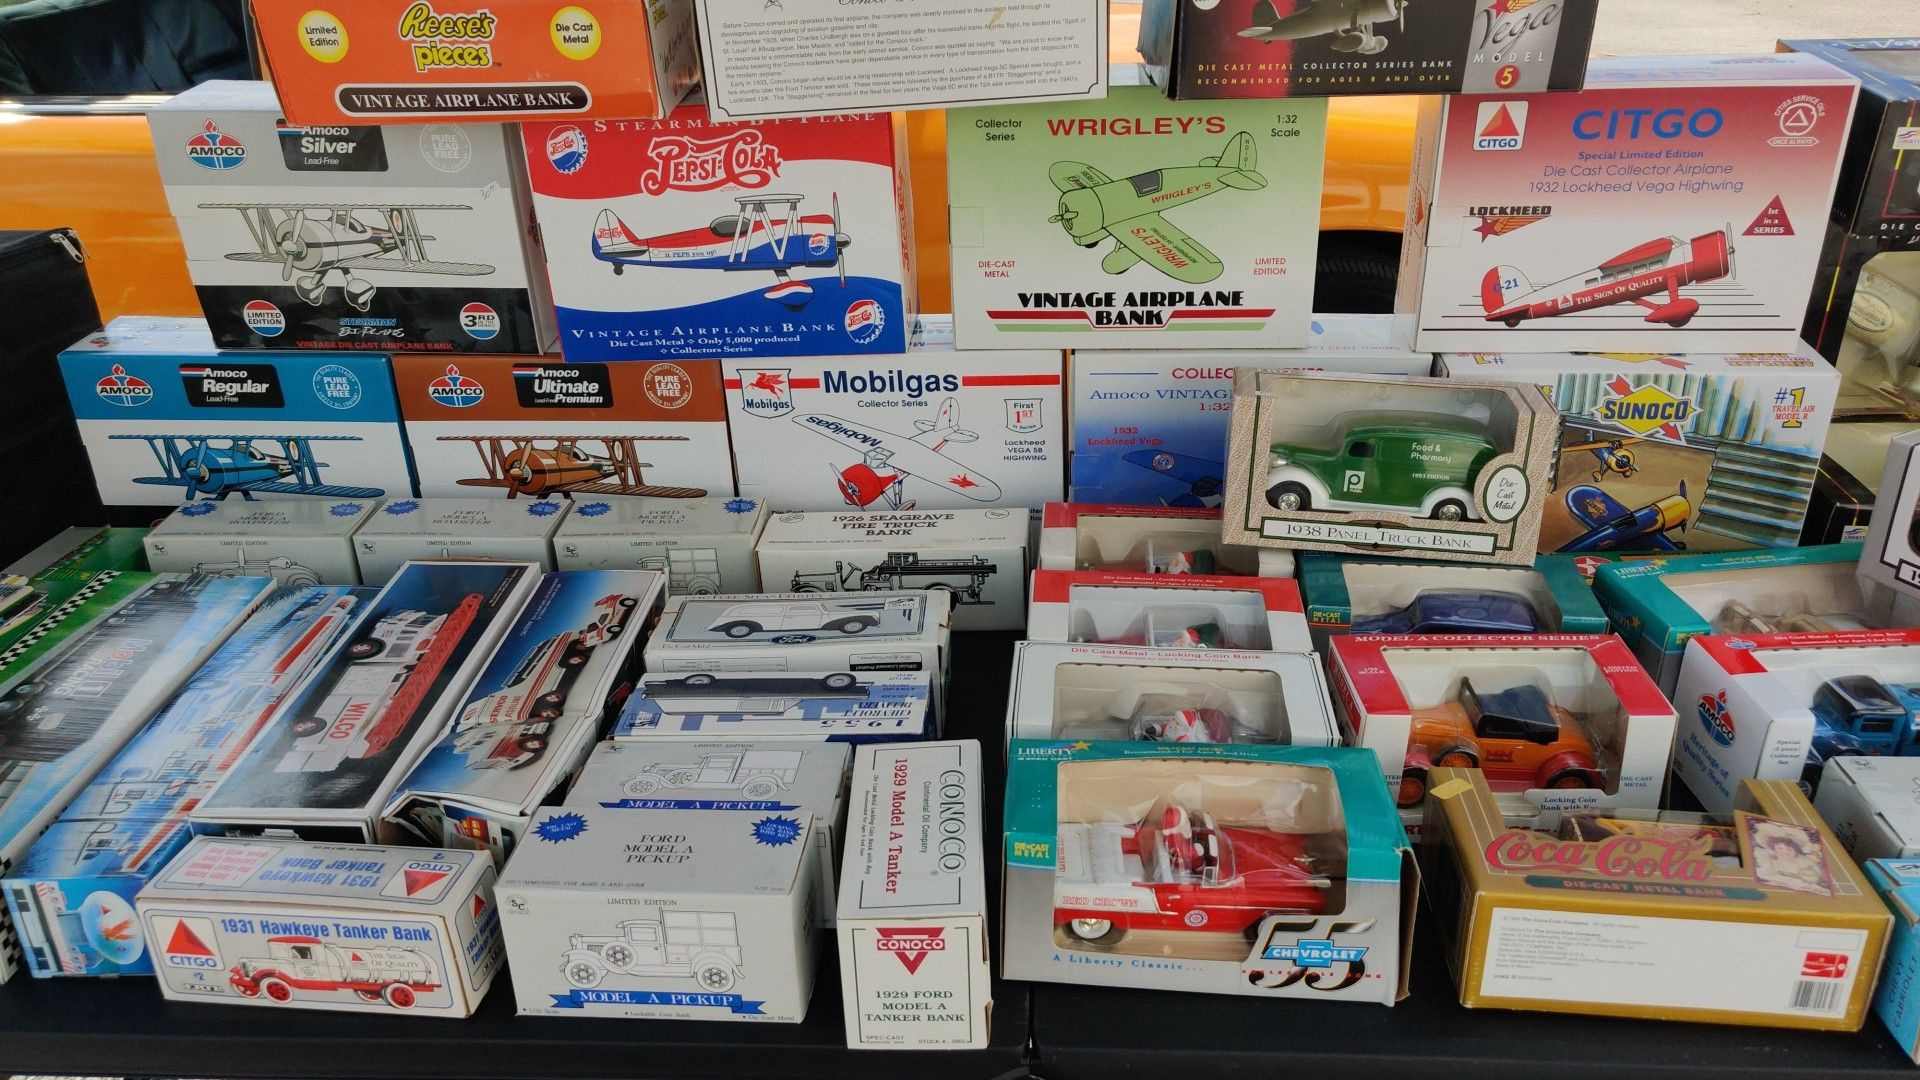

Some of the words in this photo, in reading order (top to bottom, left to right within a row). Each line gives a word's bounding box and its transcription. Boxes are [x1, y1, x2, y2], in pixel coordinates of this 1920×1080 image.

[401, 2, 495, 38] Reese's
[305, 25, 338, 37] Limited
[555, 23, 572, 33] Die
[574, 23, 594, 33] Cast
[310, 36, 339, 47] Edition
[563, 34, 589, 44] Metal
[415, 41, 489, 71] pieces
[1473, 50, 1546, 64] MODEL
[1223, 63, 1253, 71] CAST
[1259, 62, 1294, 71] METAL
[1303, 61, 1369, 70] COLLECTOR
[1375, 61, 1415, 69] SERIES
[1422, 60, 1453, 69] BANK
[1198, 76, 1290, 85] RECOMMENDED
[1299, 76, 1323, 84] FOR
[1330, 76, 1362, 84] AGES
[1385, 75, 1409, 83] AND
[1418, 73, 1452, 82] OVER
[1499, 68, 1514, 85] 5
[351, 93, 429, 109] VINTAGE
[435, 92, 521, 108] AIRPLANE
[525, 92, 574, 107] BANK
[975, 118, 1022, 129] Collector
[1276, 115, 1298, 124] 1:32
[1572, 108, 1724, 141] CITGO
[1047, 116, 1226, 137] WRIGLEY'S
[985, 131, 1015, 142] Series
[1271, 128, 1301, 138] Scale
[300, 137, 357, 154] Silver
[1478, 138, 1518, 149] CITGO
[189, 146, 246, 156] AMOCO
[1578, 151, 1617, 162] Special
[1619, 150, 1663, 160] Limited
[1665, 149, 1704, 159] Edition
[304, 157, 339, 166] Lead-Free
[1544, 165, 1567, 177] Die
[1570, 165, 1602, 177] Cast
[1605, 164, 1671, 176] Collector
[1673, 163, 1733, 177] Airplane
[1529, 181, 1560, 193] 1932
[1562, 180, 1634, 193] Lockheed
[1636, 180, 1675, 194] Vega
[1677, 179, 1744, 194] Highwing
[1151, 182, 1212, 204] WRIGLEY'S
[1469, 206, 1552, 216] LOCKHEED
[978, 260, 1016, 269] DIE-CAST
[1254, 257, 1287, 266] LIMITED
[984, 270, 1010, 278] METAL
[1253, 267, 1287, 276] EDITION
[1576, 297, 1592, 305] THE
[1594, 290, 1614, 300] SIGN
[1615, 286, 1627, 294] OF
[1628, 275, 1664, 291] QUALITY
[1017, 292, 1117, 308] VINTAGE
[1123, 291, 1244, 307] AIRPLANE
[247, 311, 282, 320] LIMITED
[1095, 310, 1164, 326] BANK
[248, 318, 283, 326] EDITION
[571, 328, 663, 339] VINTAGE
[671, 324, 773, 337] AIRPLANE
[782, 322, 837, 333] BANK
[630, 339, 652, 347] Cast
[655, 338, 684, 346] Metal
[698, 337, 724, 346] Only
[726, 336, 752, 345] 5,000
[754, 335, 801, 345] produced
[671, 346, 721, 355] Collectors
[723, 345, 753, 353] Series
[203, 368, 248, 378] Amoco
[534, 368, 579, 378] Amoco
[323, 377, 347, 385] PURE
[655, 375, 680, 383] PURE
[824, 370, 959, 399] Mobilgas
[99, 386, 151, 395] AMOCO
[203, 380, 270, 395] Regular
[431, 387, 483, 396] AMOCO
[534, 379, 599, 394] Ultimate
[656, 382, 680, 390] LEAD
[327, 390, 351, 398] FREE
[554, 393, 603, 404] Premium
[657, 389, 681, 397] FREE
[1089, 390, 1150, 400] Amoco
[206, 395, 239, 403] Lead-Free
[857, 399, 900, 408] Collector
[901, 398, 928, 408] Series
[745, 399, 790, 411] Mobilgas
[1604, 399, 1689, 422] SUNOCO
[1772, 405, 1801, 413] TRAVEL
[1801, 405, 1815, 413] AIR
[1004, 438, 1046, 447] Lockheed
[1412, 442, 1433, 453] Food
[1434, 444, 1441, 452] &
[1003, 454, 1047, 462] HIGHWING
[1411, 452, 1452, 464] Pharmacy
[869, 513, 955, 522] SEAGRAVE
[884, 521, 938, 529] TRUCK
[1286, 524, 1321, 537] 1938
[329, 703, 369, 739] WILCO
[1699, 701, 1735, 740] AMOCO
[1018, 748, 1074, 757] LIBERTY
[895, 758, 908, 786] 1929
[1544, 796, 1578, 804] Locking
[891, 790, 907, 827] Model
[939, 769, 967, 874] CONOCO
[640, 834, 687, 843] FORD
[890, 831, 904, 842] A
[623, 844, 680, 854] MODEL
[684, 845, 694, 854] A
[1014, 850, 1051, 859] METAL
[624, 854, 691, 864] PICKUP
[885, 845, 902, 895] Tanker
[607, 898, 642, 906] LIMITED
[220, 918, 255, 934] 1931
[260, 919, 330, 939] Hawkeye
[334, 923, 388, 938] Tanker
[393, 926, 433, 942] Bank
[876, 939, 945, 951] CONOCO
[1272, 949, 1358, 960] CHEVROLET
[170, 955, 218, 968] CITGO
[579, 991, 636, 1004] MODEL
[649, 993, 660, 1004] A
[671, 993, 733, 1007] PICKUP
[876, 991, 909, 999] 1929
[914, 990, 953, 998] FORD
[882, 1002, 933, 1010] MODEL
[937, 1002, 947, 1010] A
[864, 1013, 921, 1022] TANKER
[927, 1013, 965, 1022] BANK
